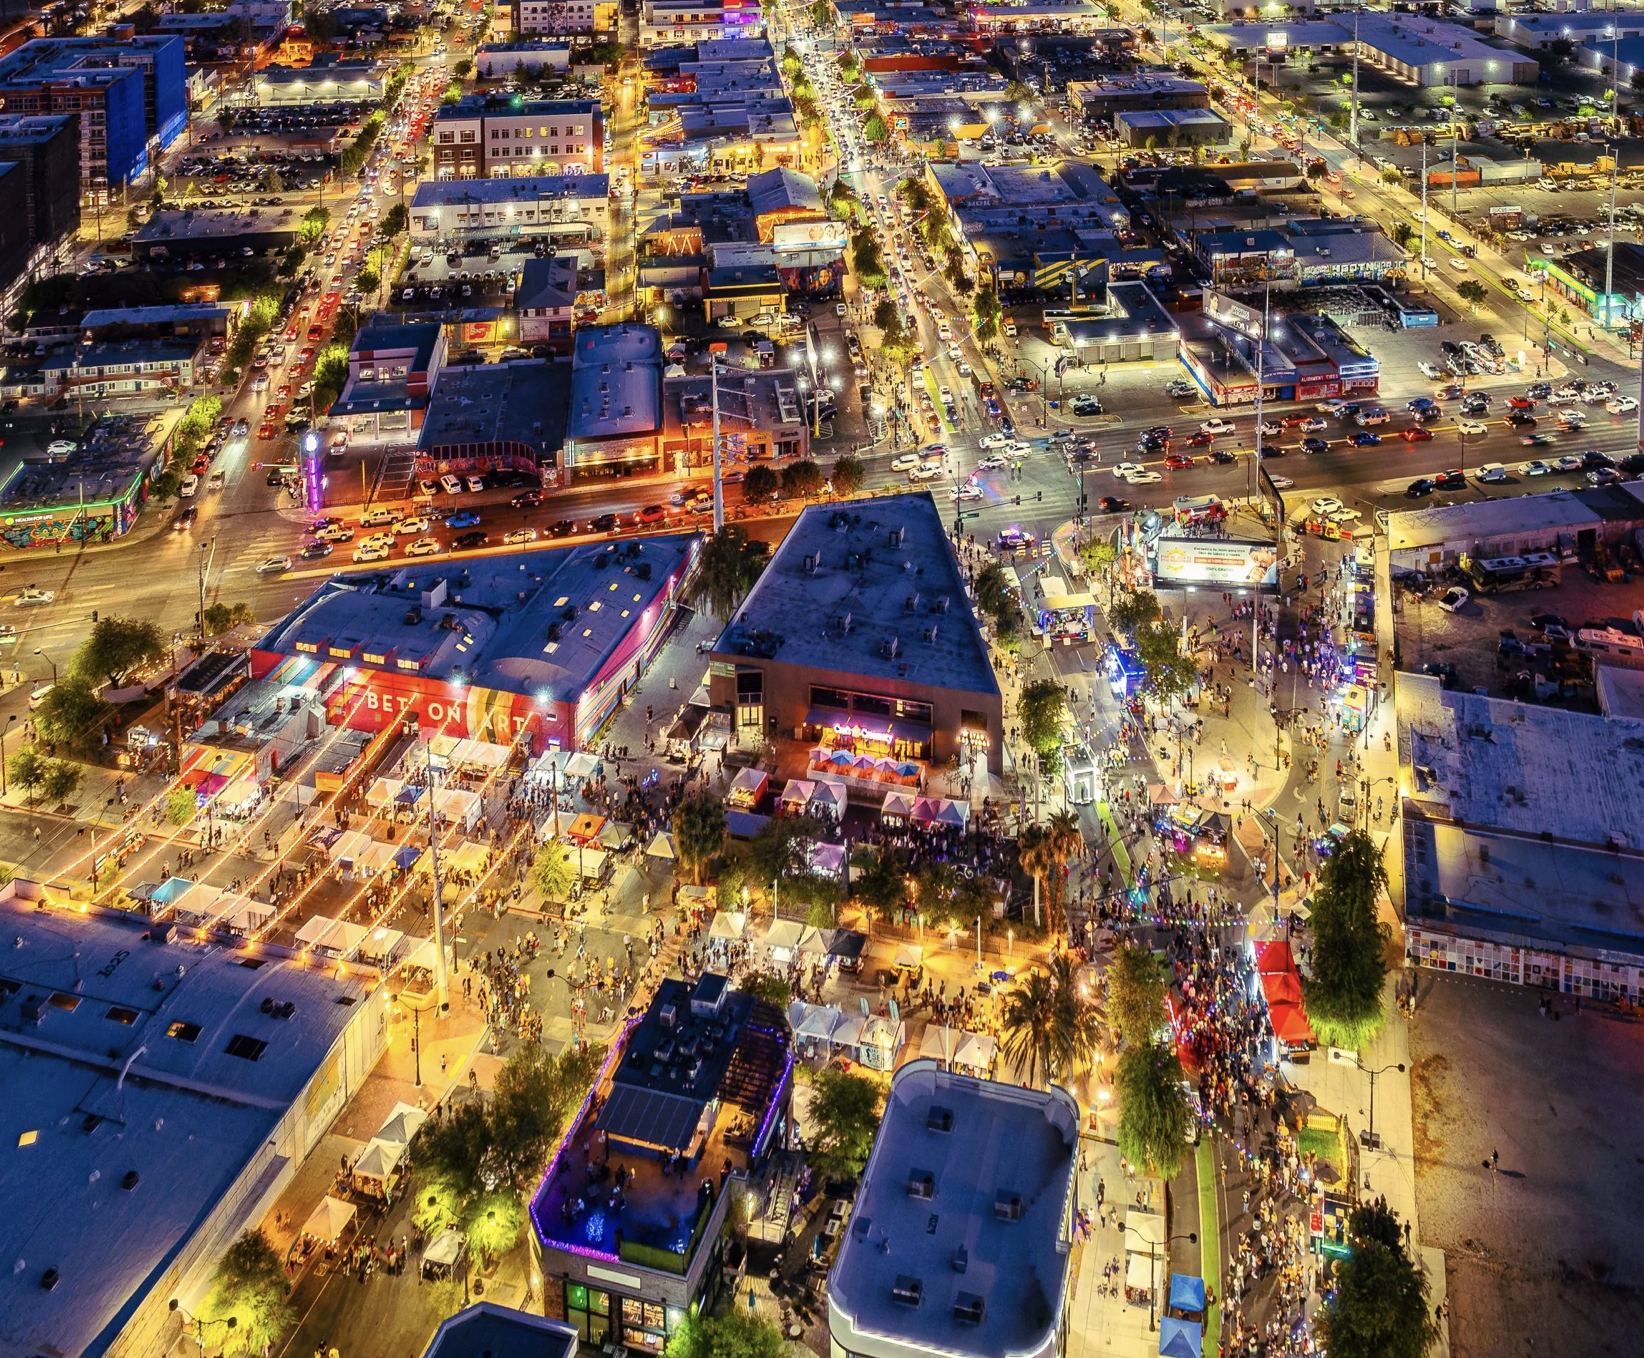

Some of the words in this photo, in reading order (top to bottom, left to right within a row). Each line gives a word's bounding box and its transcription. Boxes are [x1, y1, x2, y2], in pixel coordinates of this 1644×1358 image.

[367, 692, 409, 713] BET
[427, 702, 461, 724] ON
[484, 712, 525, 733] ART
[96, 950, 130, 979] 1025
